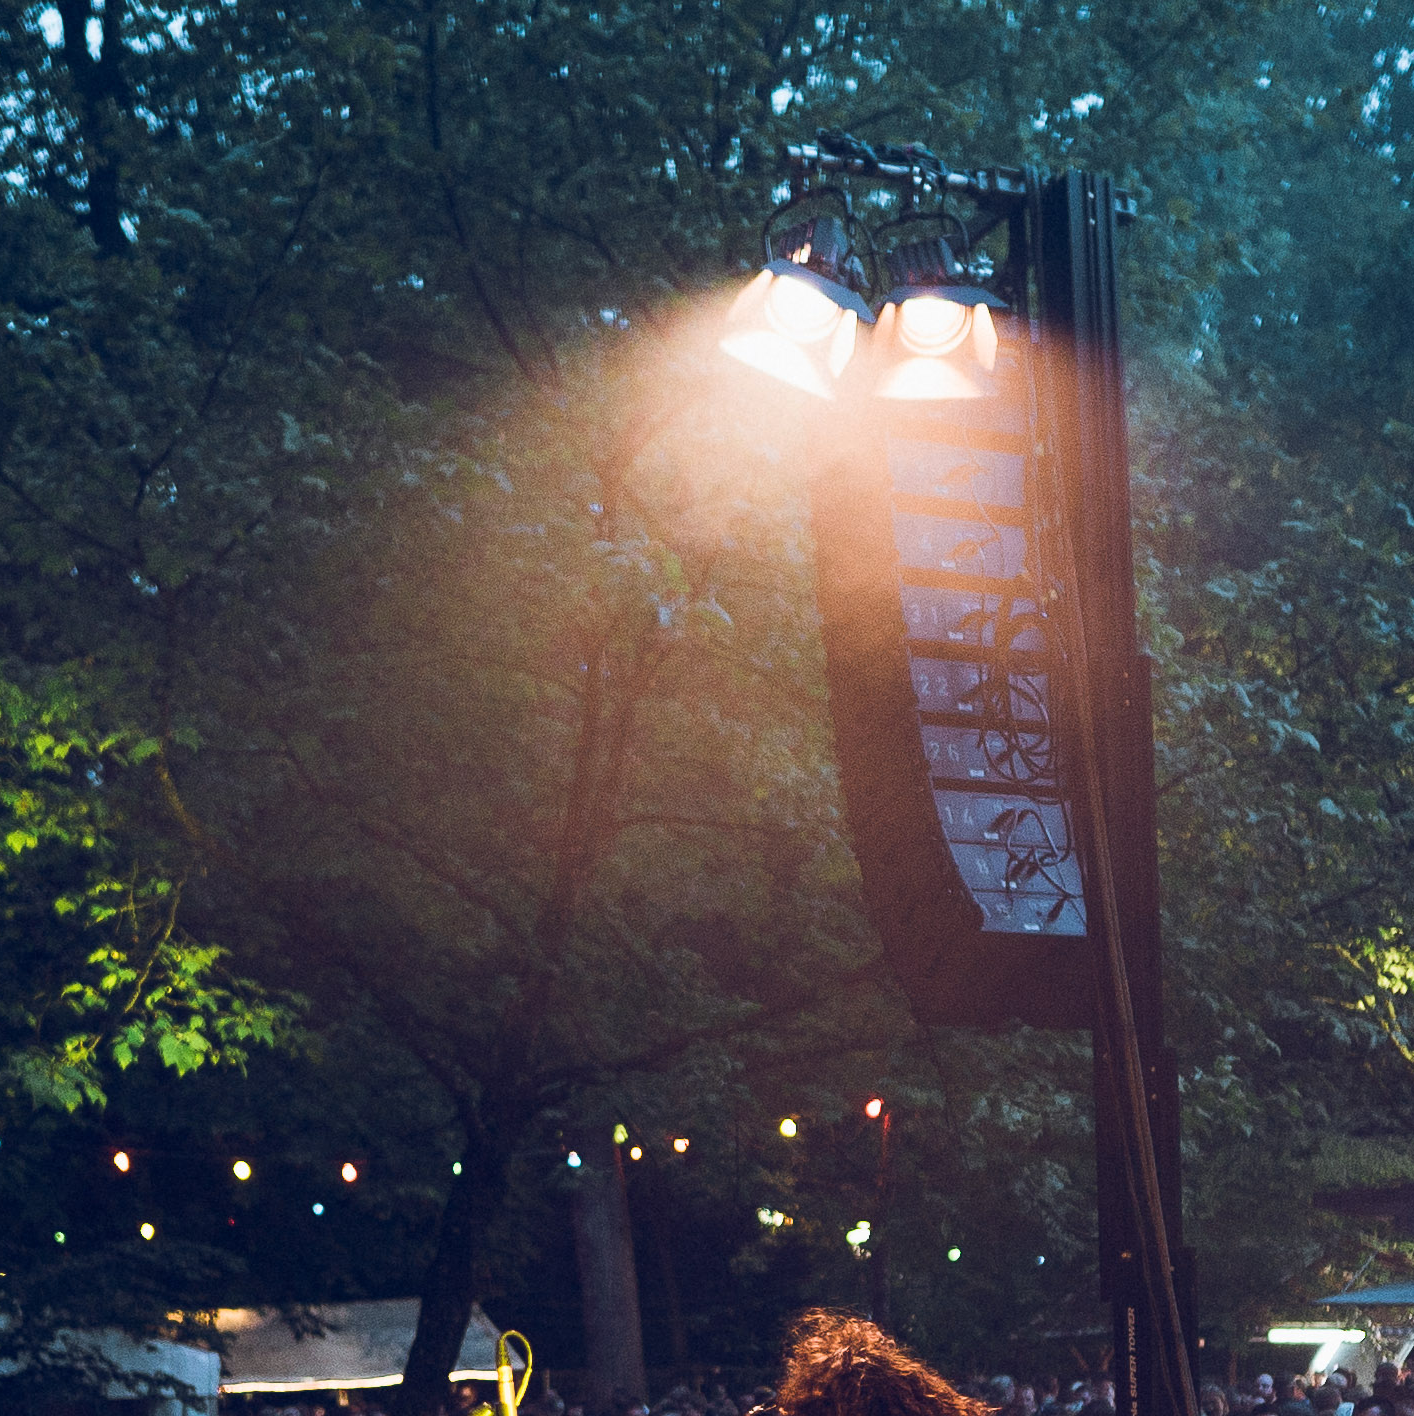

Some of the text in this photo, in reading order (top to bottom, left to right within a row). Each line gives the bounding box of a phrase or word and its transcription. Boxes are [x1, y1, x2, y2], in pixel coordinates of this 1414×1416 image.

[919, 673, 948, 697] 22
[1128, 1307, 1137, 1352] TOWER
[1129, 1355, 1138, 1398] SUPER
